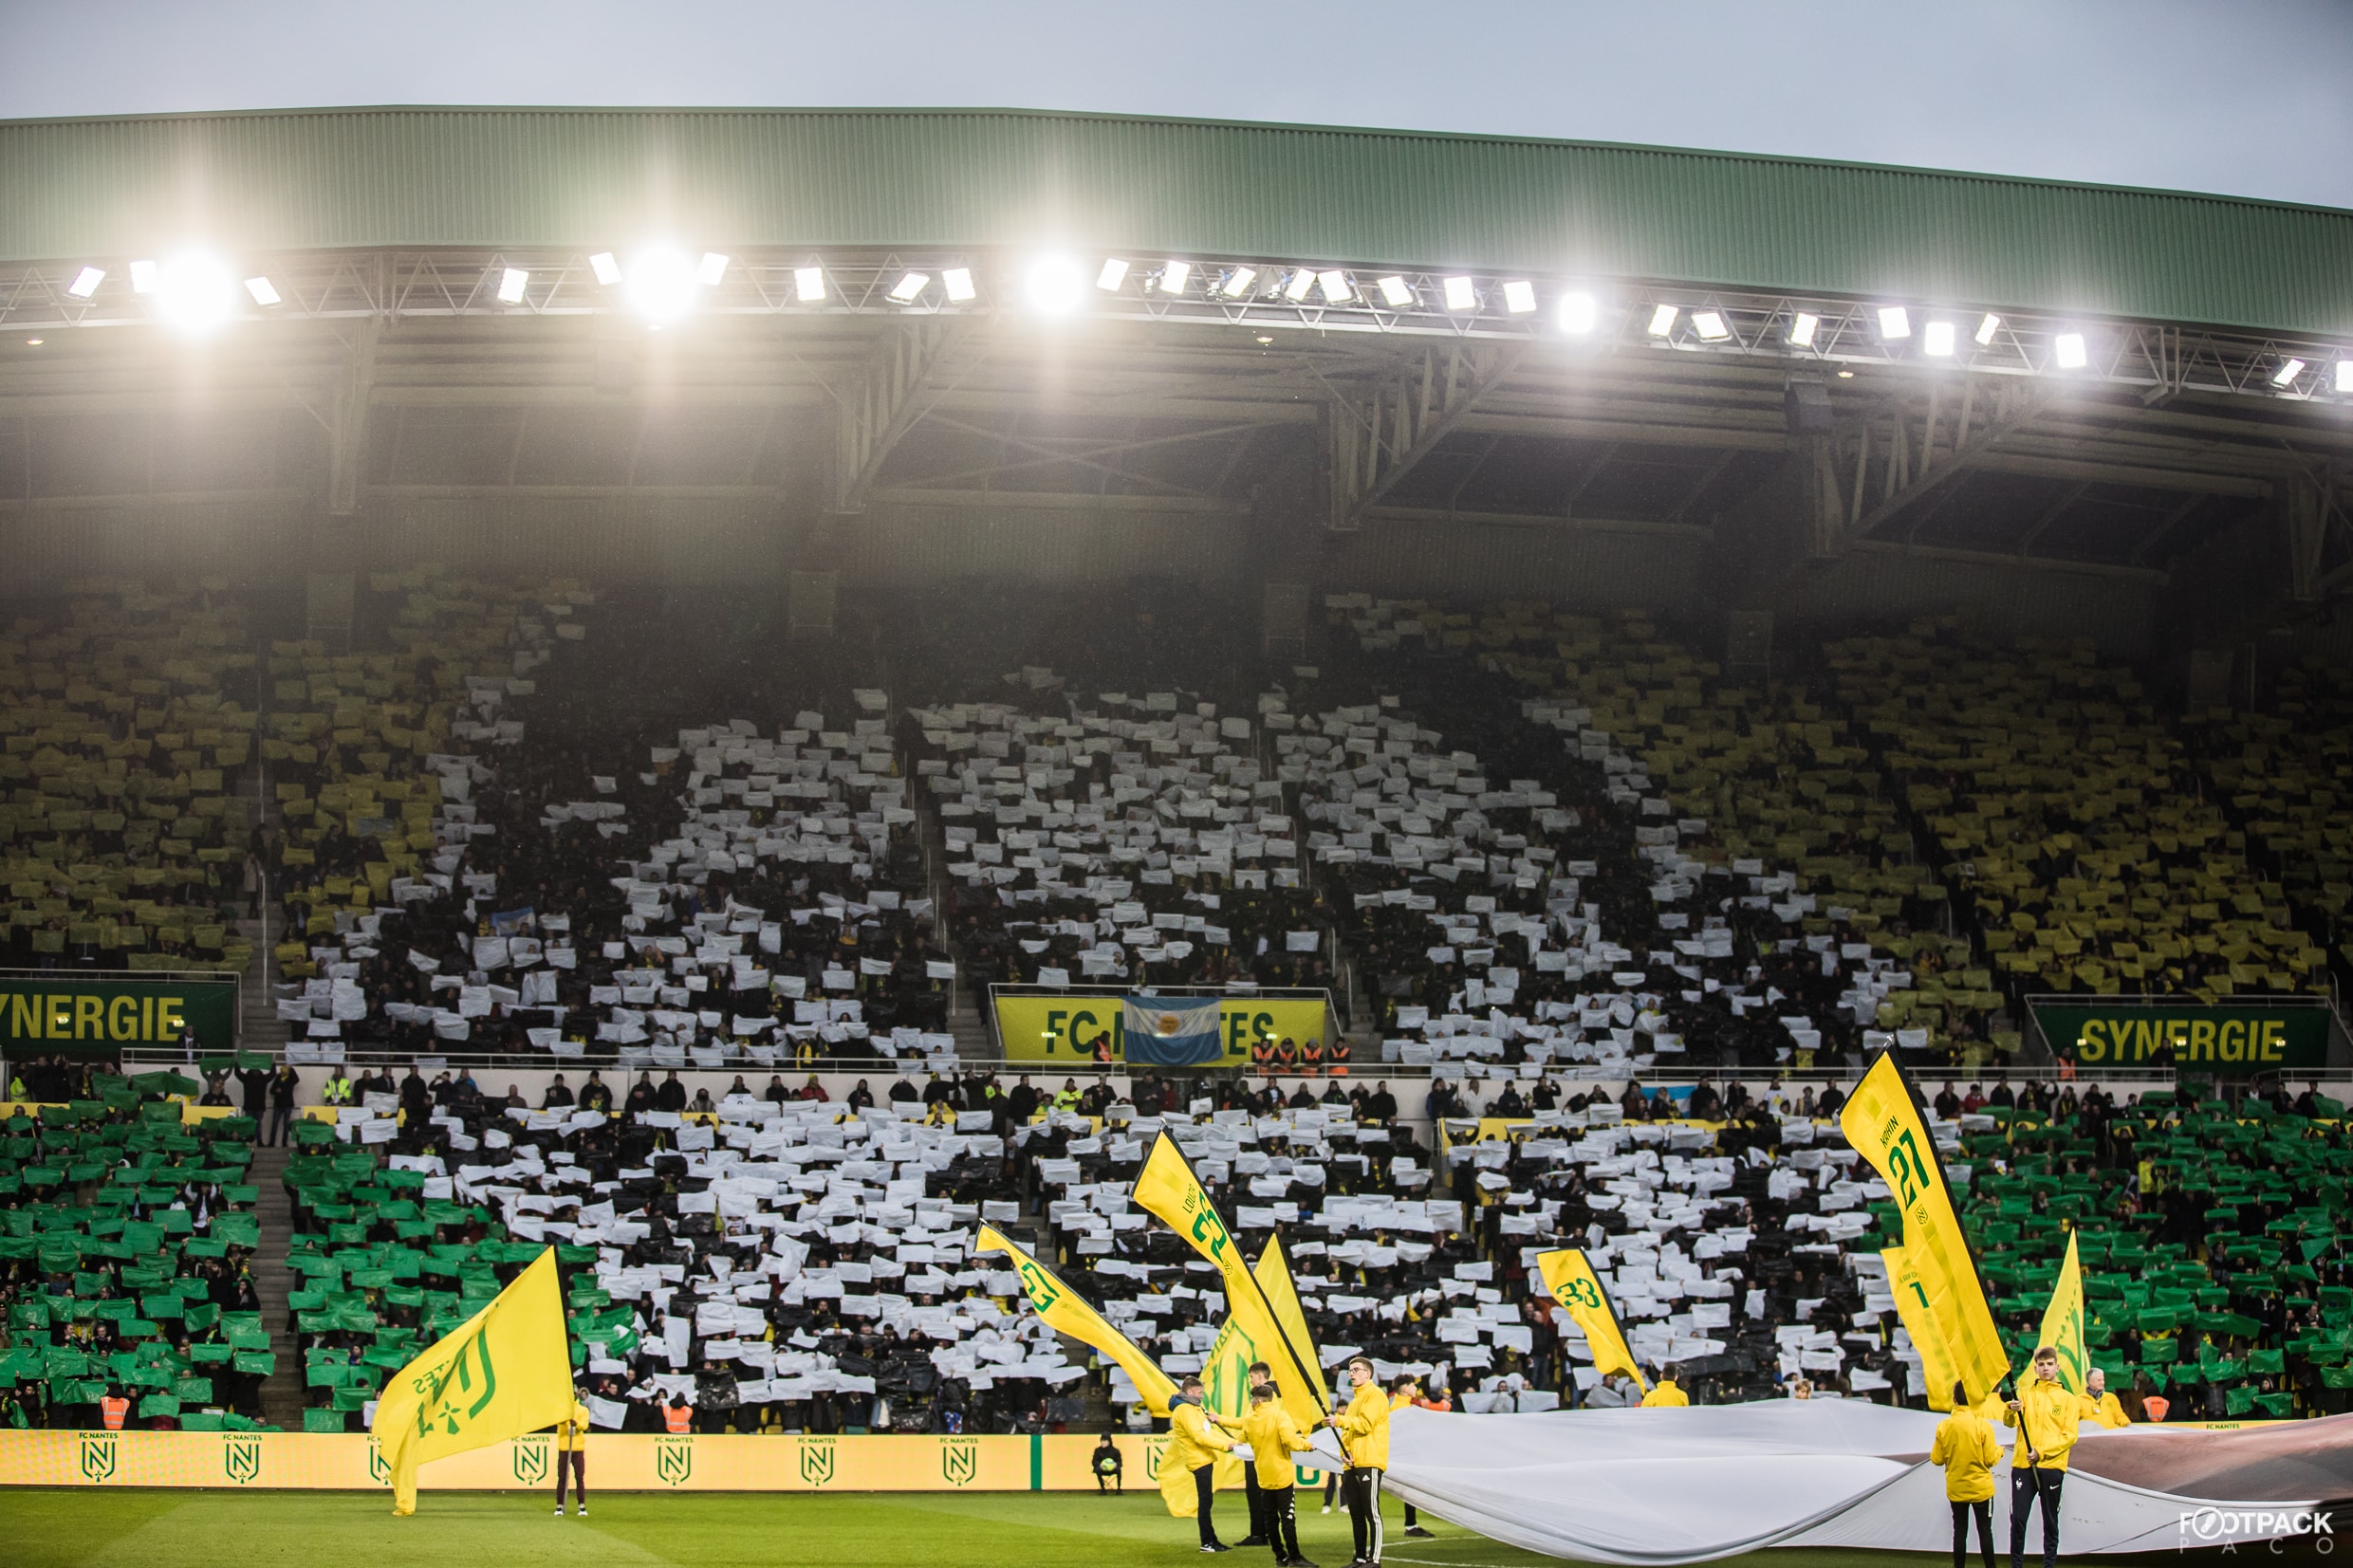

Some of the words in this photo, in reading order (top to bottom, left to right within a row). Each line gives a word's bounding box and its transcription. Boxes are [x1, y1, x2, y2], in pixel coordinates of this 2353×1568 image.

[1046, 1010, 1099, 1055] FC
[2080, 1019, 2285, 1061] SYNERGIE
[1889, 1127, 1930, 1212] 27
[1556, 1278, 1601, 1308] 33
[1909, 1282, 1930, 1309] 1
